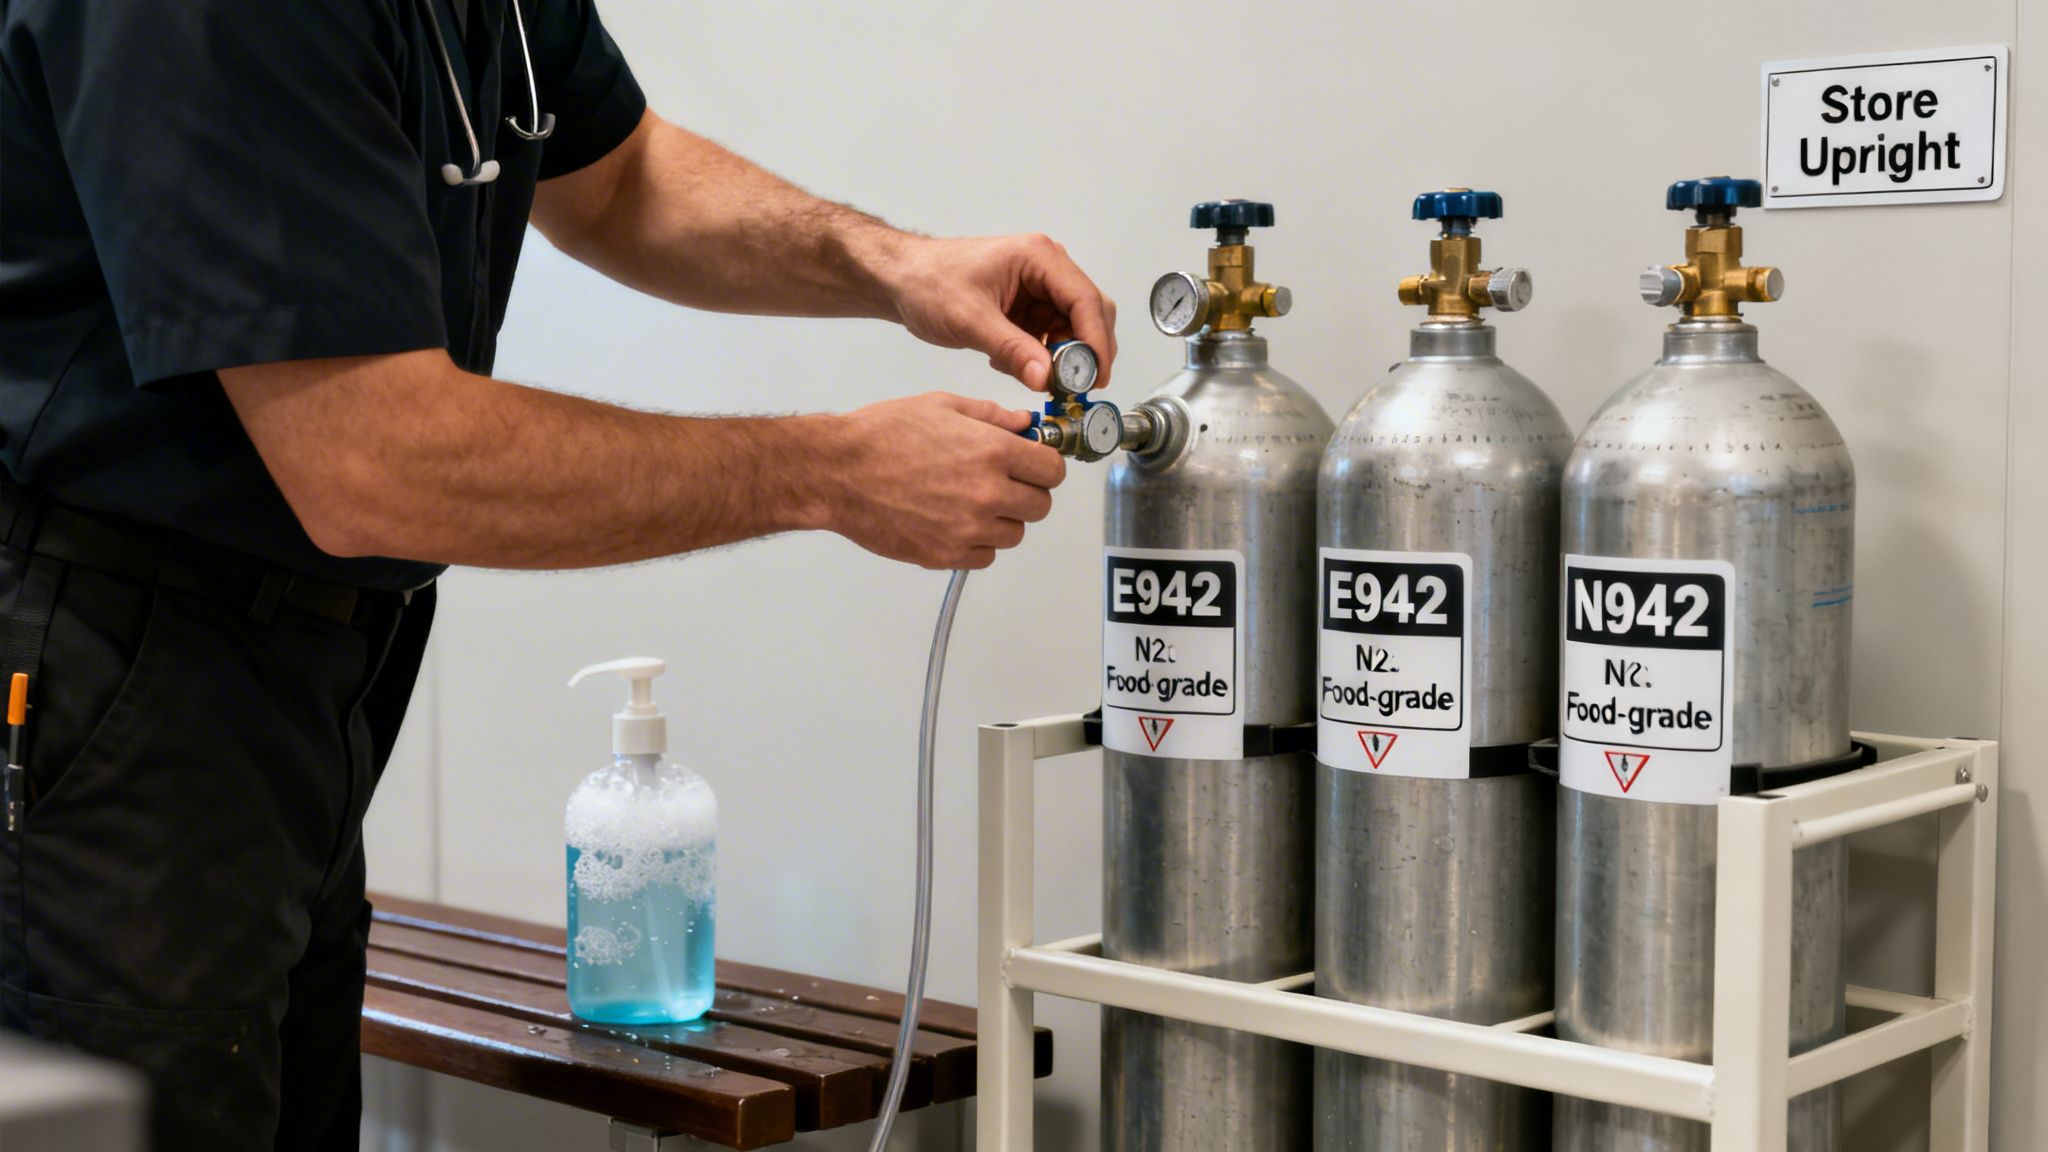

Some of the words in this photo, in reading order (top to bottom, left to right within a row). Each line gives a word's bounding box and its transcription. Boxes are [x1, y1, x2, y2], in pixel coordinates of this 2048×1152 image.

[1821, 85, 1938, 123] Store
[1800, 131, 1960, 185] Upright
[1112, 567, 1221, 616] E942
[1329, 570, 1448, 624] E942
[1574, 578, 1709, 637] N942
[1322, 676, 1454, 717] Food-grade
[1567, 691, 1713, 735] Food-grade
